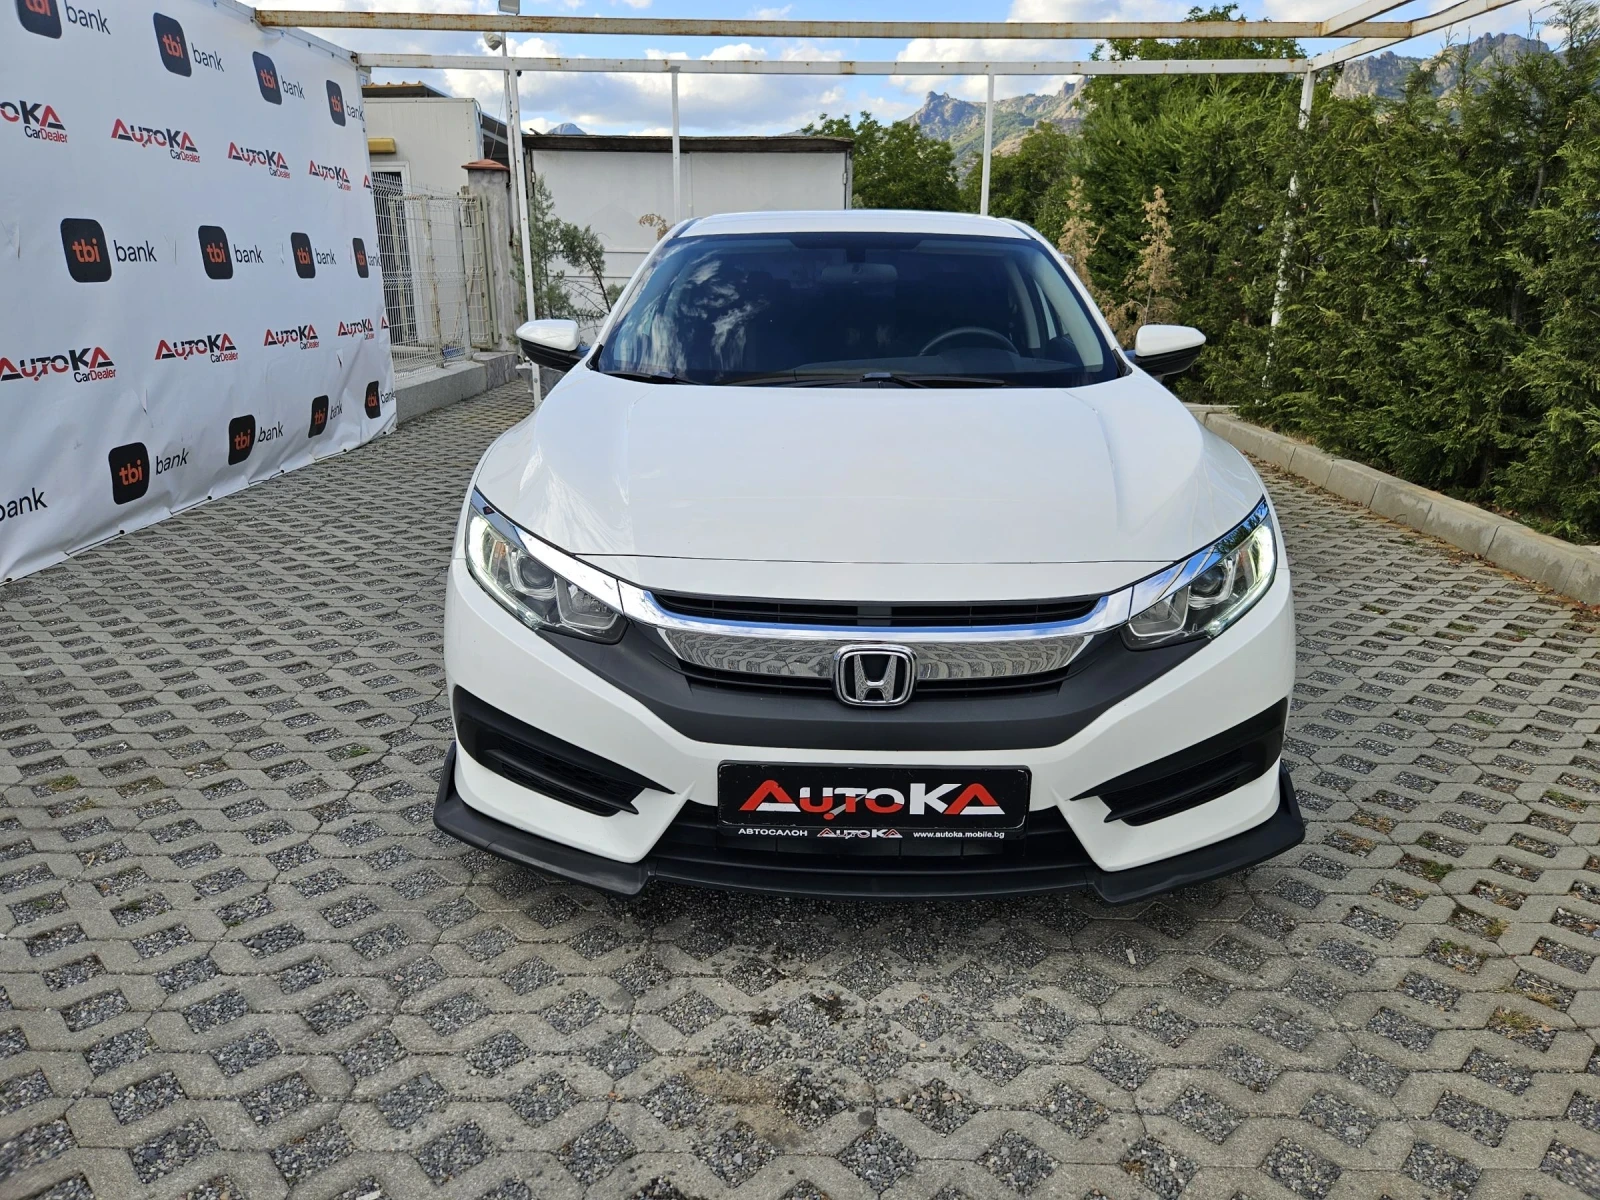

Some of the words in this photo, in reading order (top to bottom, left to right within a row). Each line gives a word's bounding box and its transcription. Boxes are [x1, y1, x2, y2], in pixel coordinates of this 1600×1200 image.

[64, 0, 111, 35] bank
[162, 34, 184, 59] tbi
[191, 43, 225, 72] bank
[260, 69, 277, 90] tbi
[281, 75, 305, 100] bank
[331, 96, 342, 113] tbi
[345, 100, 365, 122] bank
[24, 126, 68, 143] CarDealer
[169, 149, 201, 163] CarDealer
[72, 238, 101, 263] tbi
[113, 240, 158, 263] bank
[206, 242, 226, 263] tbi
[233, 244, 264, 264] bank
[297, 246, 311, 265] tbi
[315, 248, 337, 265] bank
[210, 351, 239, 363] CarDealer
[73, 369, 117, 383] CarDealer
[380, 388, 396, 404] bank
[314, 407, 326, 425] tbi
[330, 400, 343, 420] bank
[233, 429, 251, 450] tbi
[257, 421, 284, 443] bank
[119, 459, 143, 486] tbi
[155, 448, 189, 475] bank
[739, 779, 1006, 820] AUTOKA
[913, 830, 1006, 839] www.autoka.mobile.bg
